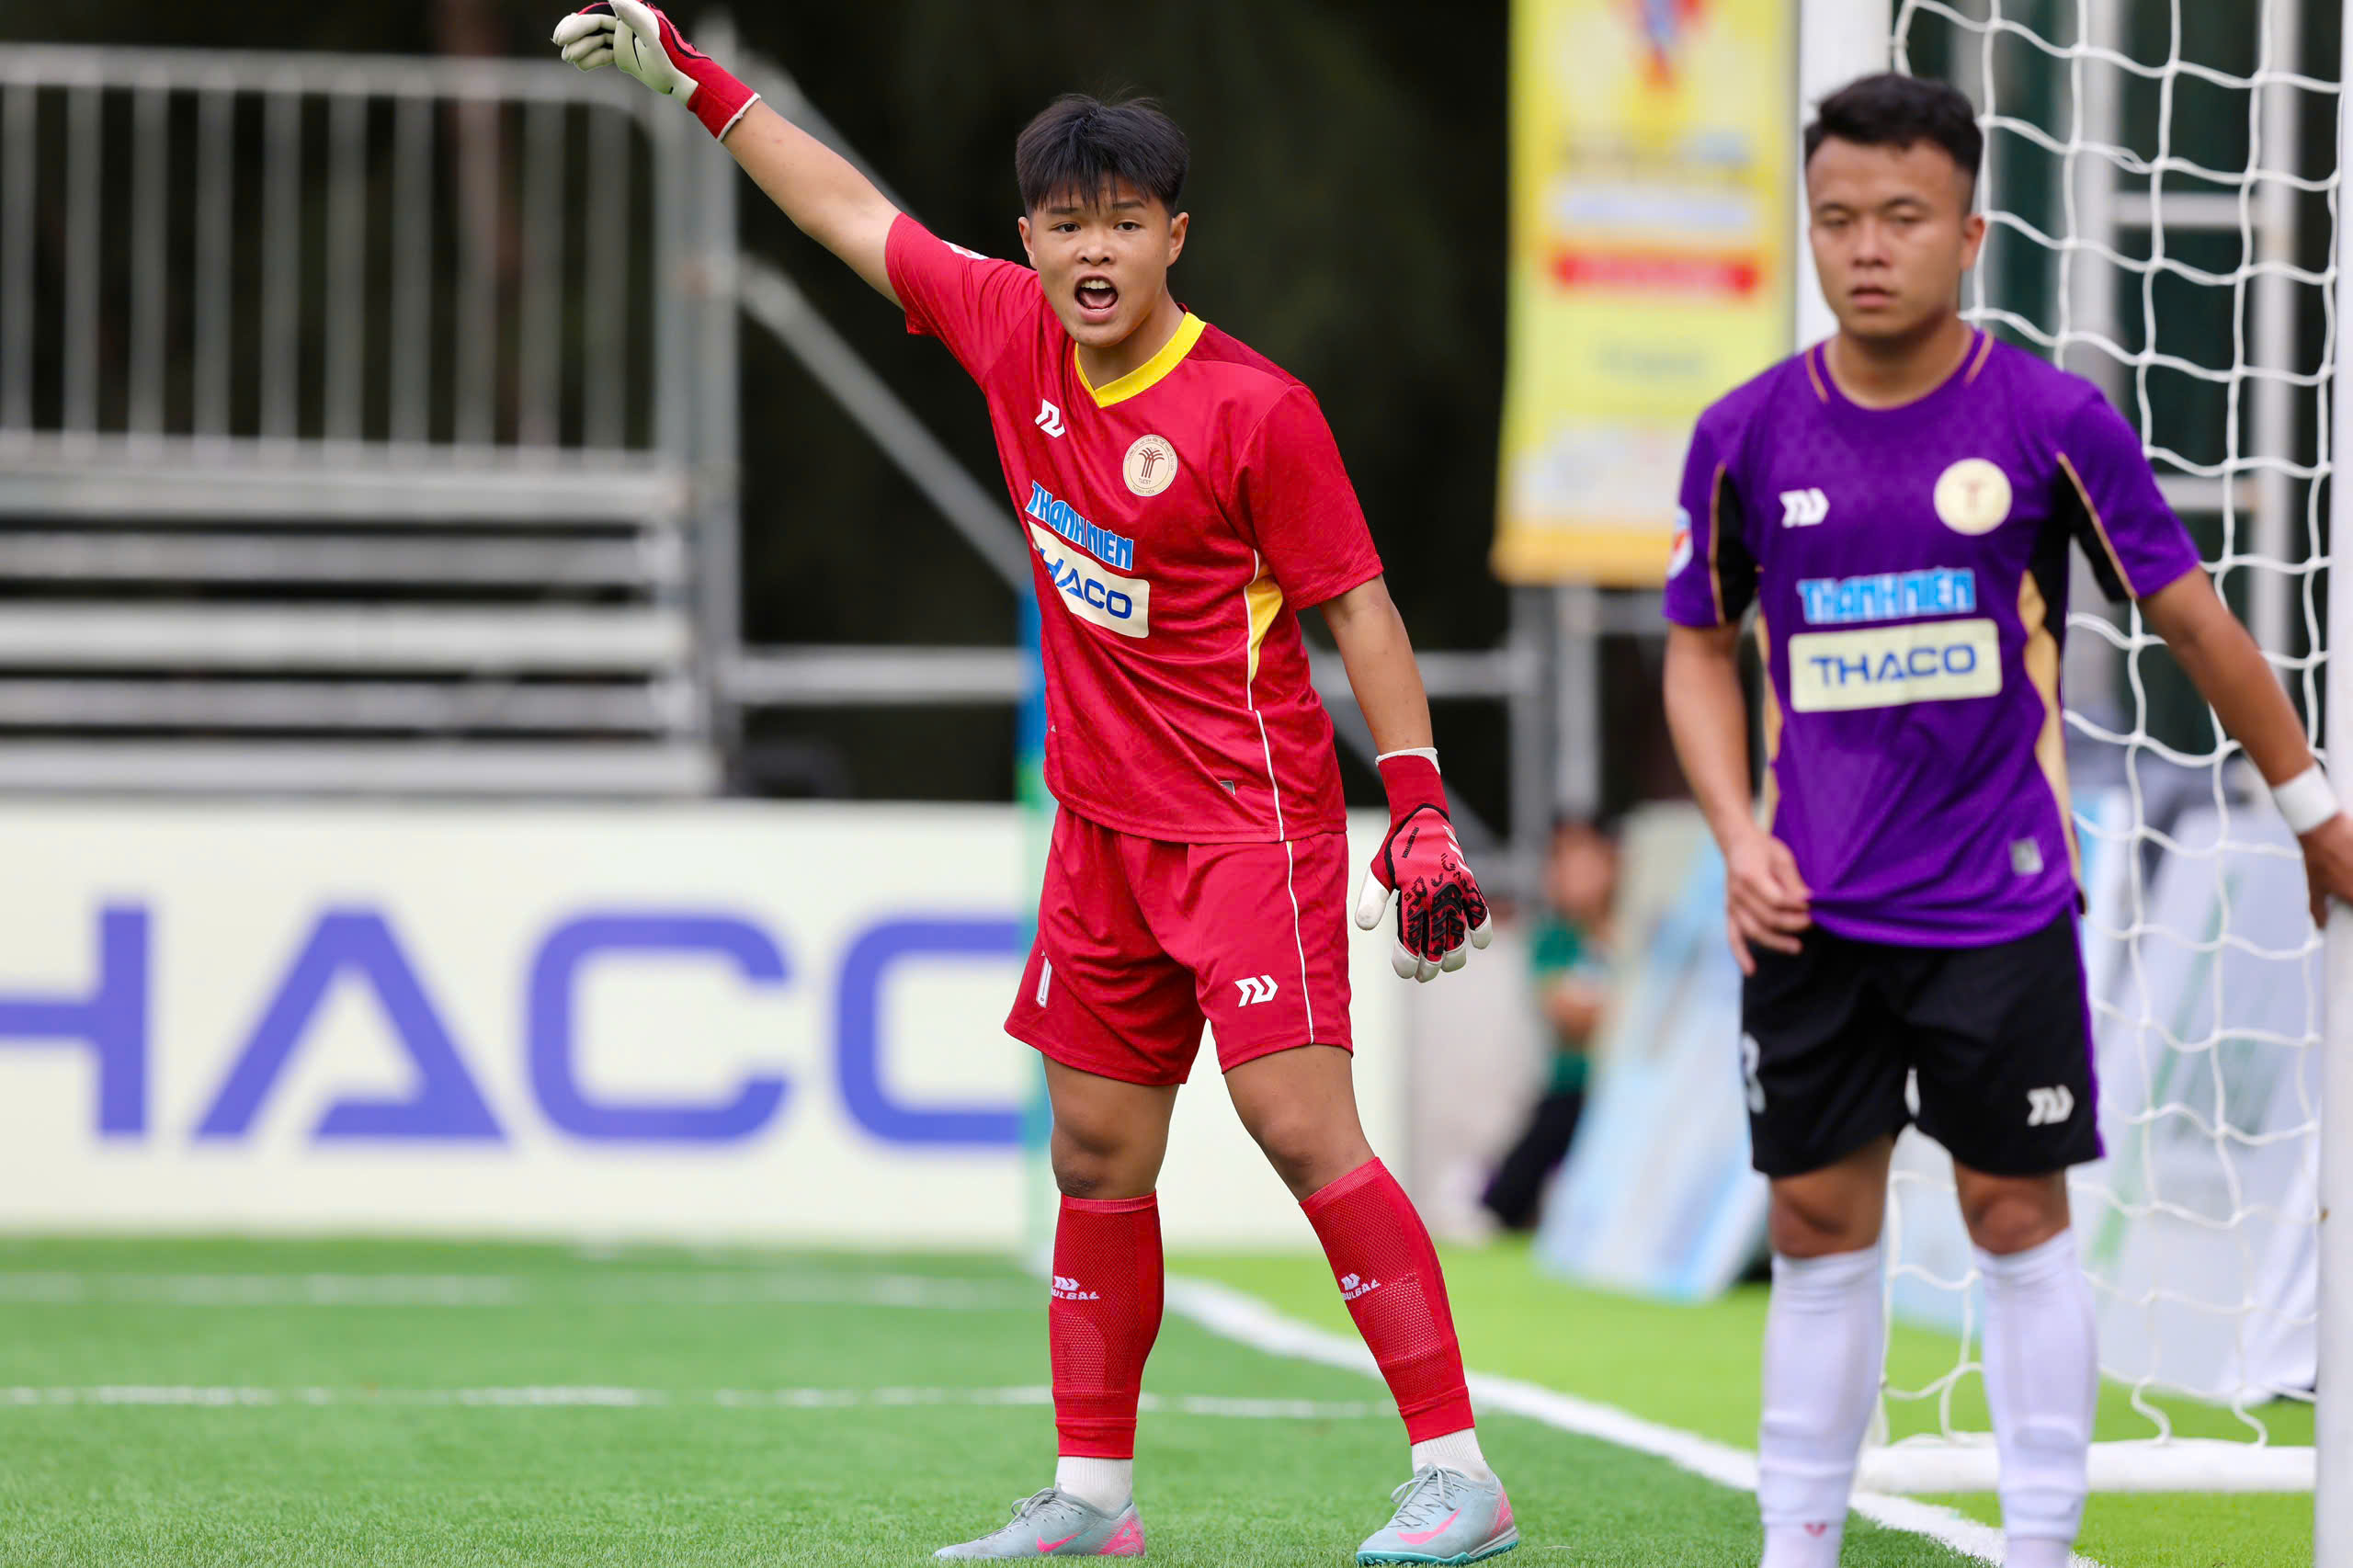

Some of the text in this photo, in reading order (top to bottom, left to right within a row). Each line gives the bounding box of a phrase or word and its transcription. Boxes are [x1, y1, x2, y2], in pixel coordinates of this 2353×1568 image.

[1026, 480, 1134, 571] THANH NIÊN
[1809, 644, 1976, 687] THACO
